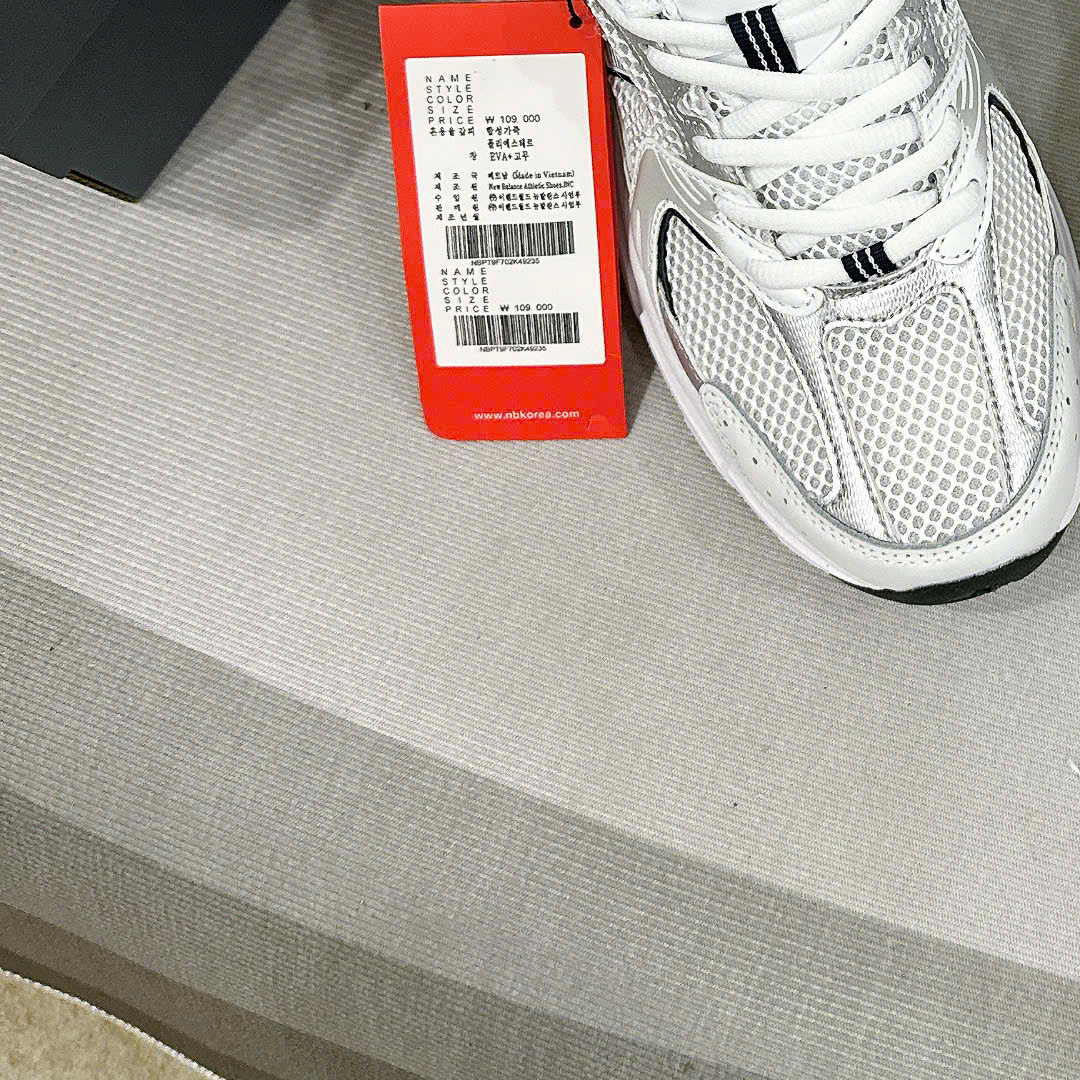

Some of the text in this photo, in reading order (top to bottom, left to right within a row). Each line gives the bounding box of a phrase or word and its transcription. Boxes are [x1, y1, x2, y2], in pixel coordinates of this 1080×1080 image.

[425, 73, 472, 83] NAME
[425, 84, 472, 94] STYLE
[426, 95, 474, 104] COLOR
[427, 105, 474, 115] SIZE
[428, 116, 474, 125] PRICE
[441, 267, 487, 276] NAME
[441, 277, 487, 286] STYLE
[443, 287, 489, 296] COLOR
[444, 296, 489, 304] SIZE
[445, 305, 489, 313] PRICE
[474, 410, 580, 420] www.nbkorea.com
